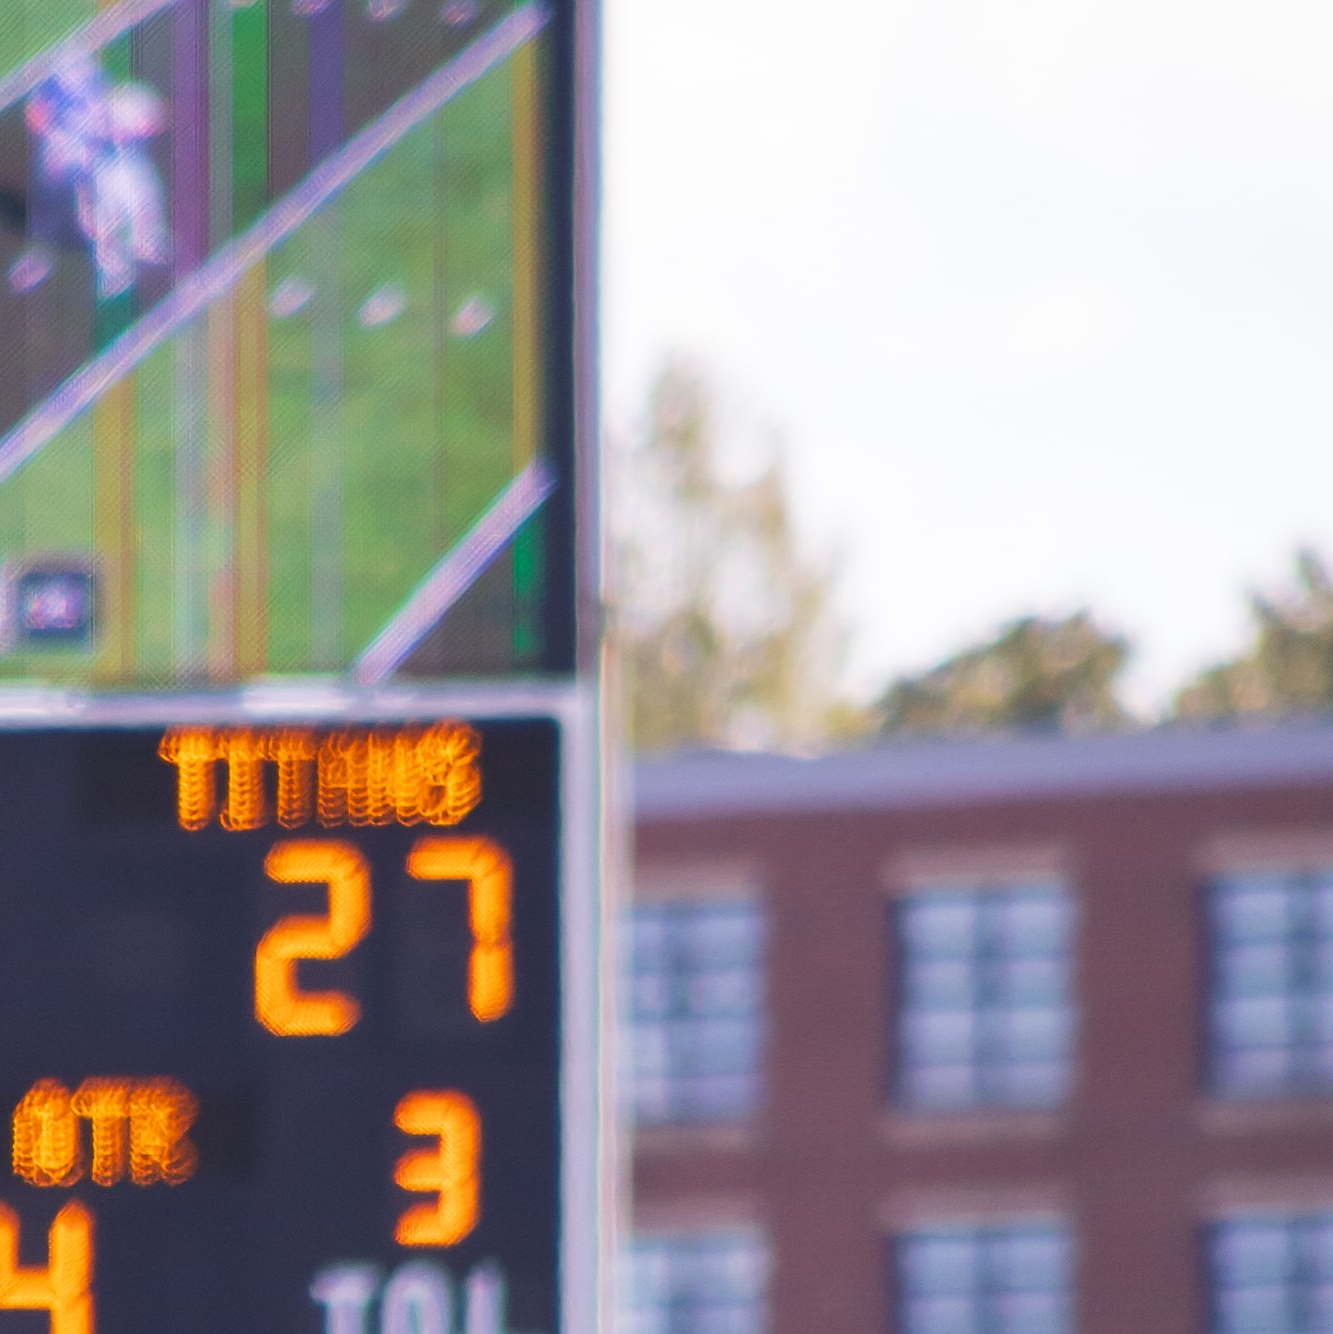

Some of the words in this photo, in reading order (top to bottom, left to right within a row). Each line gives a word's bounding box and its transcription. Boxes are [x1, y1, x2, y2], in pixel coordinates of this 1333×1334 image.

[159, 722, 481, 831] TITANS
[254, 836, 513, 1036] 27
[12, 1078, 192, 1187] QTR
[393, 1091, 481, 1247] 3
